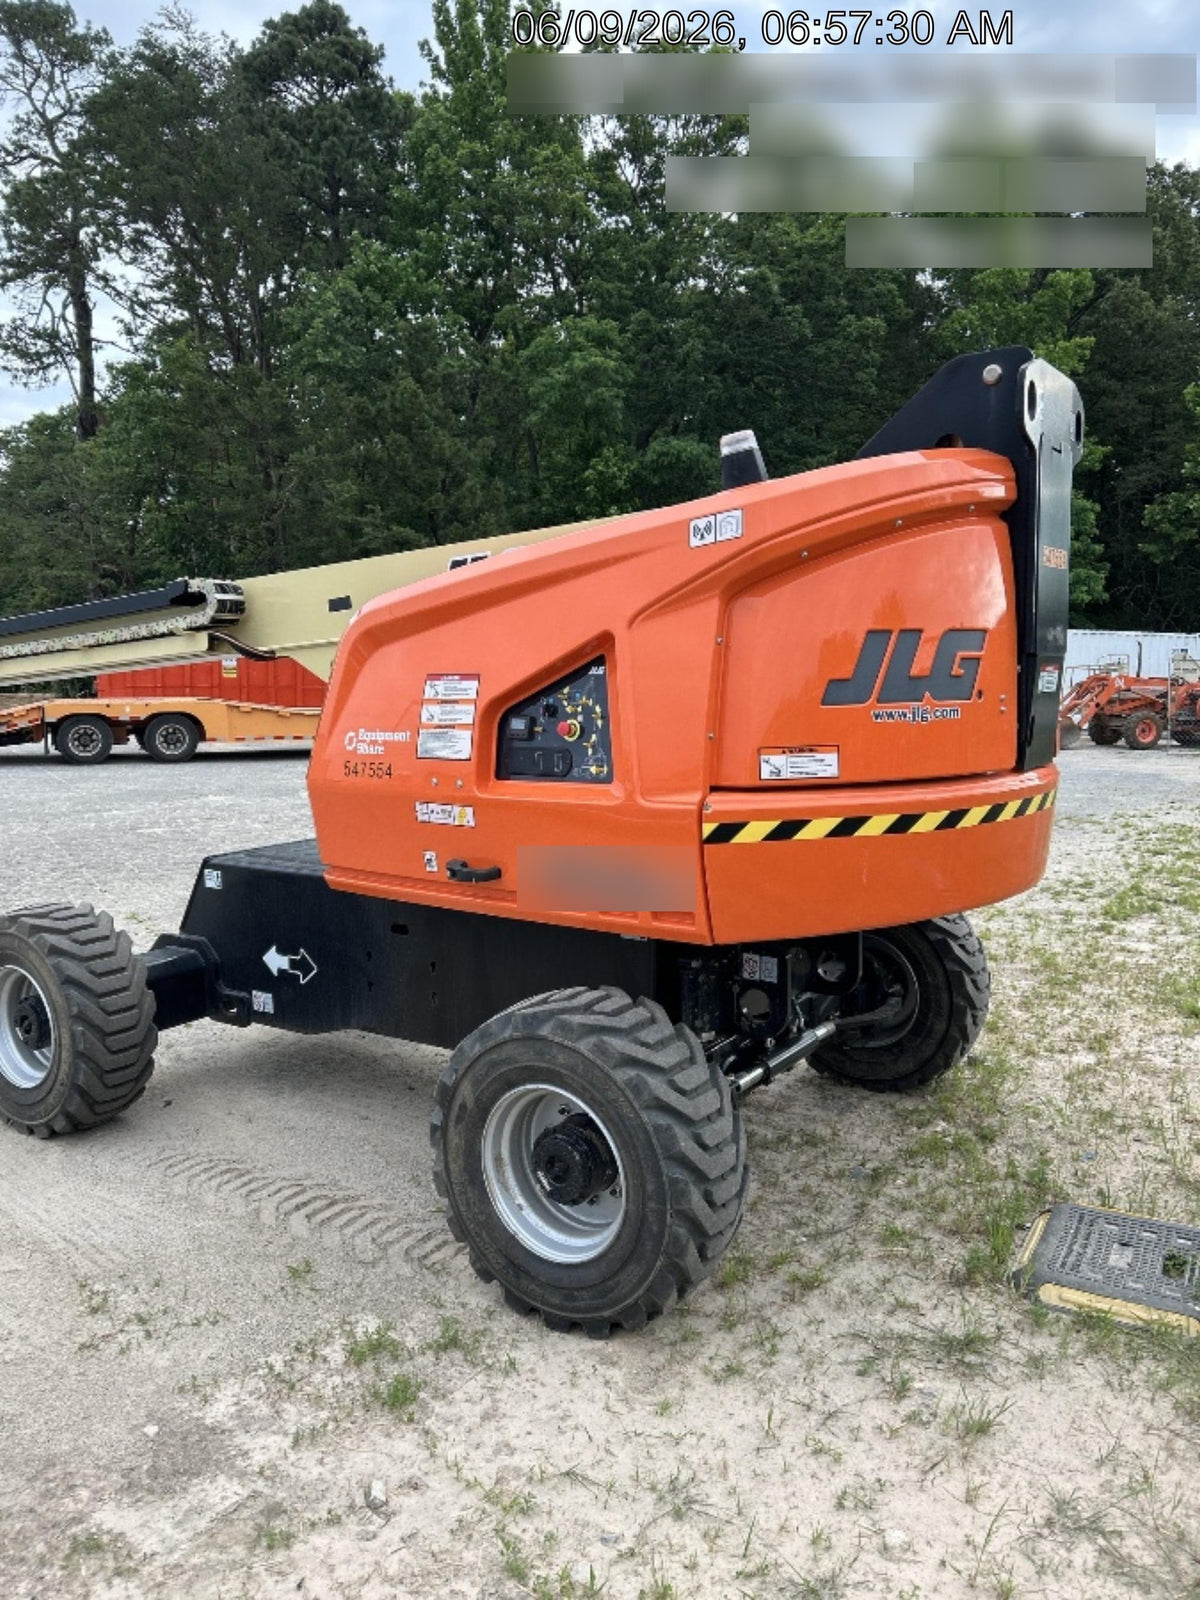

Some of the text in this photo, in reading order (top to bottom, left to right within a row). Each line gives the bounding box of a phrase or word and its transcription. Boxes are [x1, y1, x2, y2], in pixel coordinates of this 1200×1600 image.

[821, 629, 987, 706] JLG
[872, 706, 961, 724] www.jlg.com
[344, 760, 393, 780] 547554
